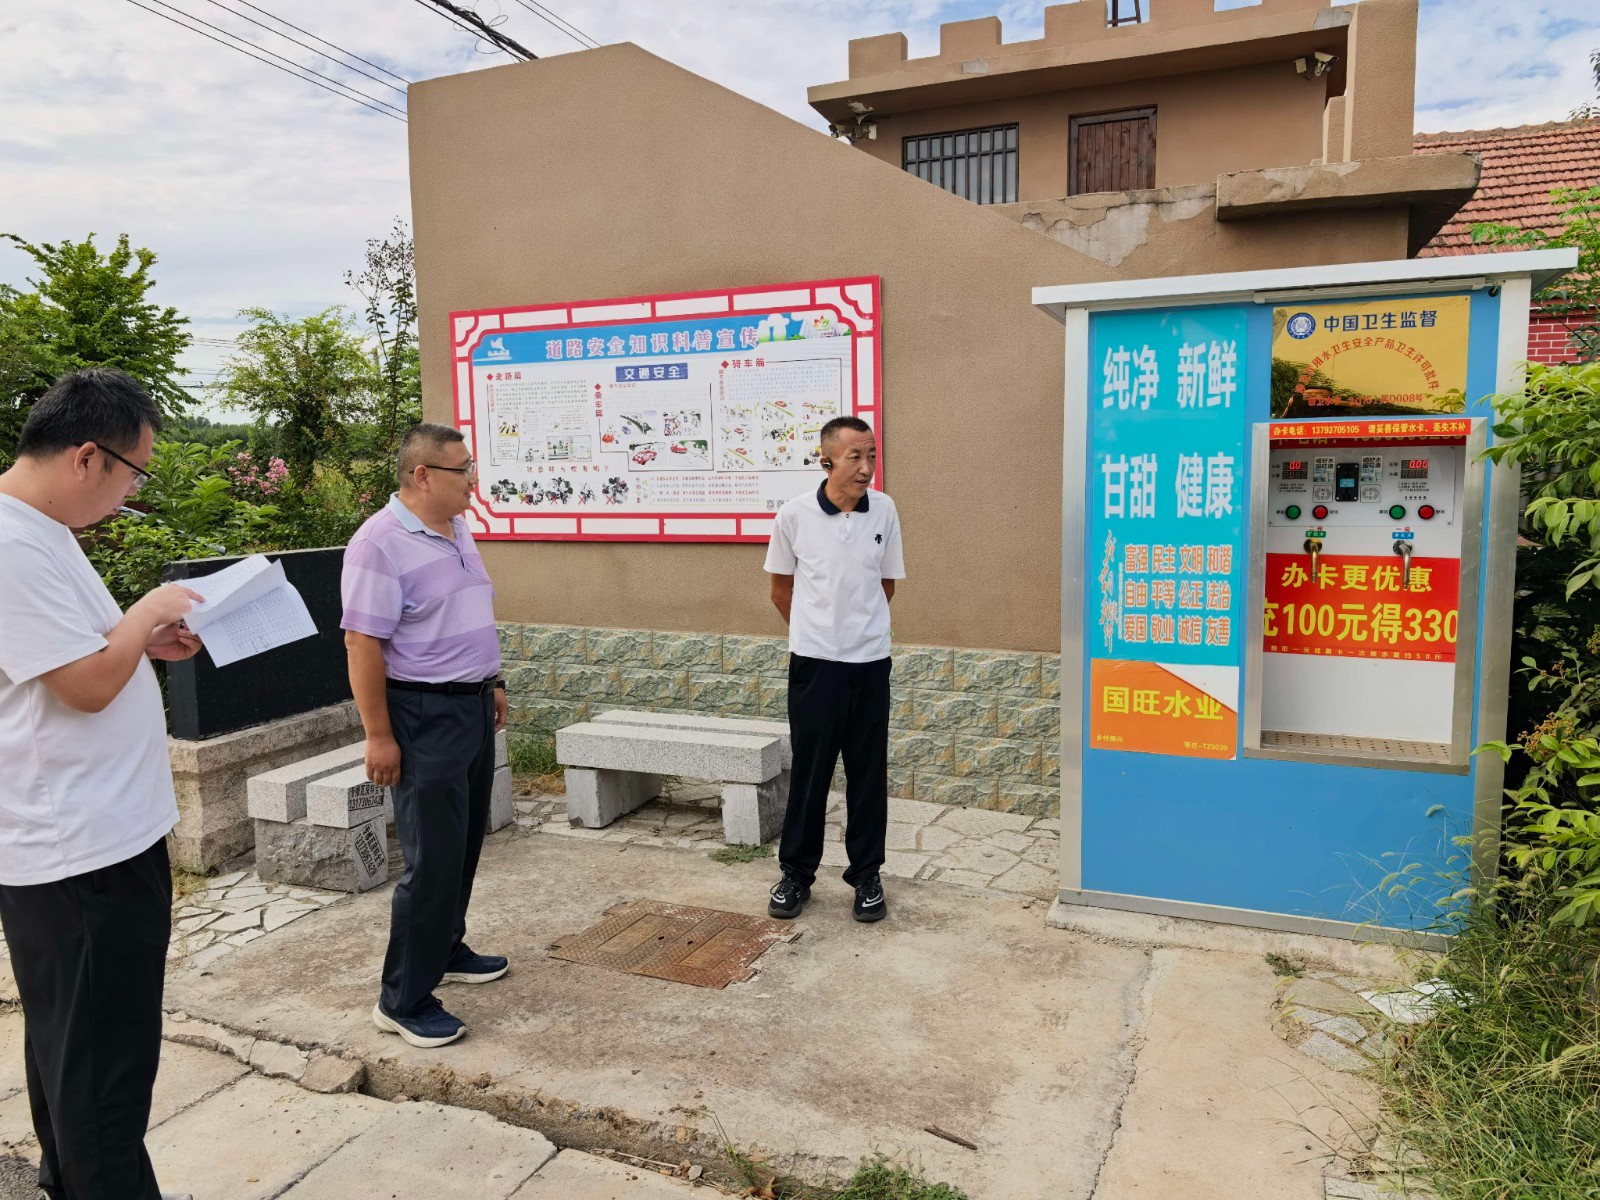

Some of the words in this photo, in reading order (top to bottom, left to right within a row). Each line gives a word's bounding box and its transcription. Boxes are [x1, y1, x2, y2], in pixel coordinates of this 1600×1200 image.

[1323, 310, 1438, 333] 中国卫生监督
[545, 326, 759, 360] 道路安全知识科普宣传
[623, 365, 682, 381] 交通安全
[1102, 344, 1160, 411] 纯净
[1176, 339, 1237, 410] 新鲜
[1101, 453, 1158, 519] 甘甜
[1175, 451, 1235, 520] 健康
[1125, 544, 1148, 573] 富强
[1152, 544, 1176, 574] 民主
[1179, 544, 1204, 574] 文明
[1207, 544, 1232, 575] 和谐
[1280, 562, 1433, 593] 办卡更优惠
[1125, 579, 1148, 607] 自由
[1151, 580, 1175, 609] 平等
[1179, 580, 1203, 610] 公正
[1206, 580, 1231, 610] 法治
[1124, 614, 1148, 642] 爱国
[1151, 614, 1175, 644] 敬业
[1178, 614, 1202, 645] 诚信
[1205, 615, 1230, 646] 友善
[1103, 685, 1224, 720] 国旺水业
